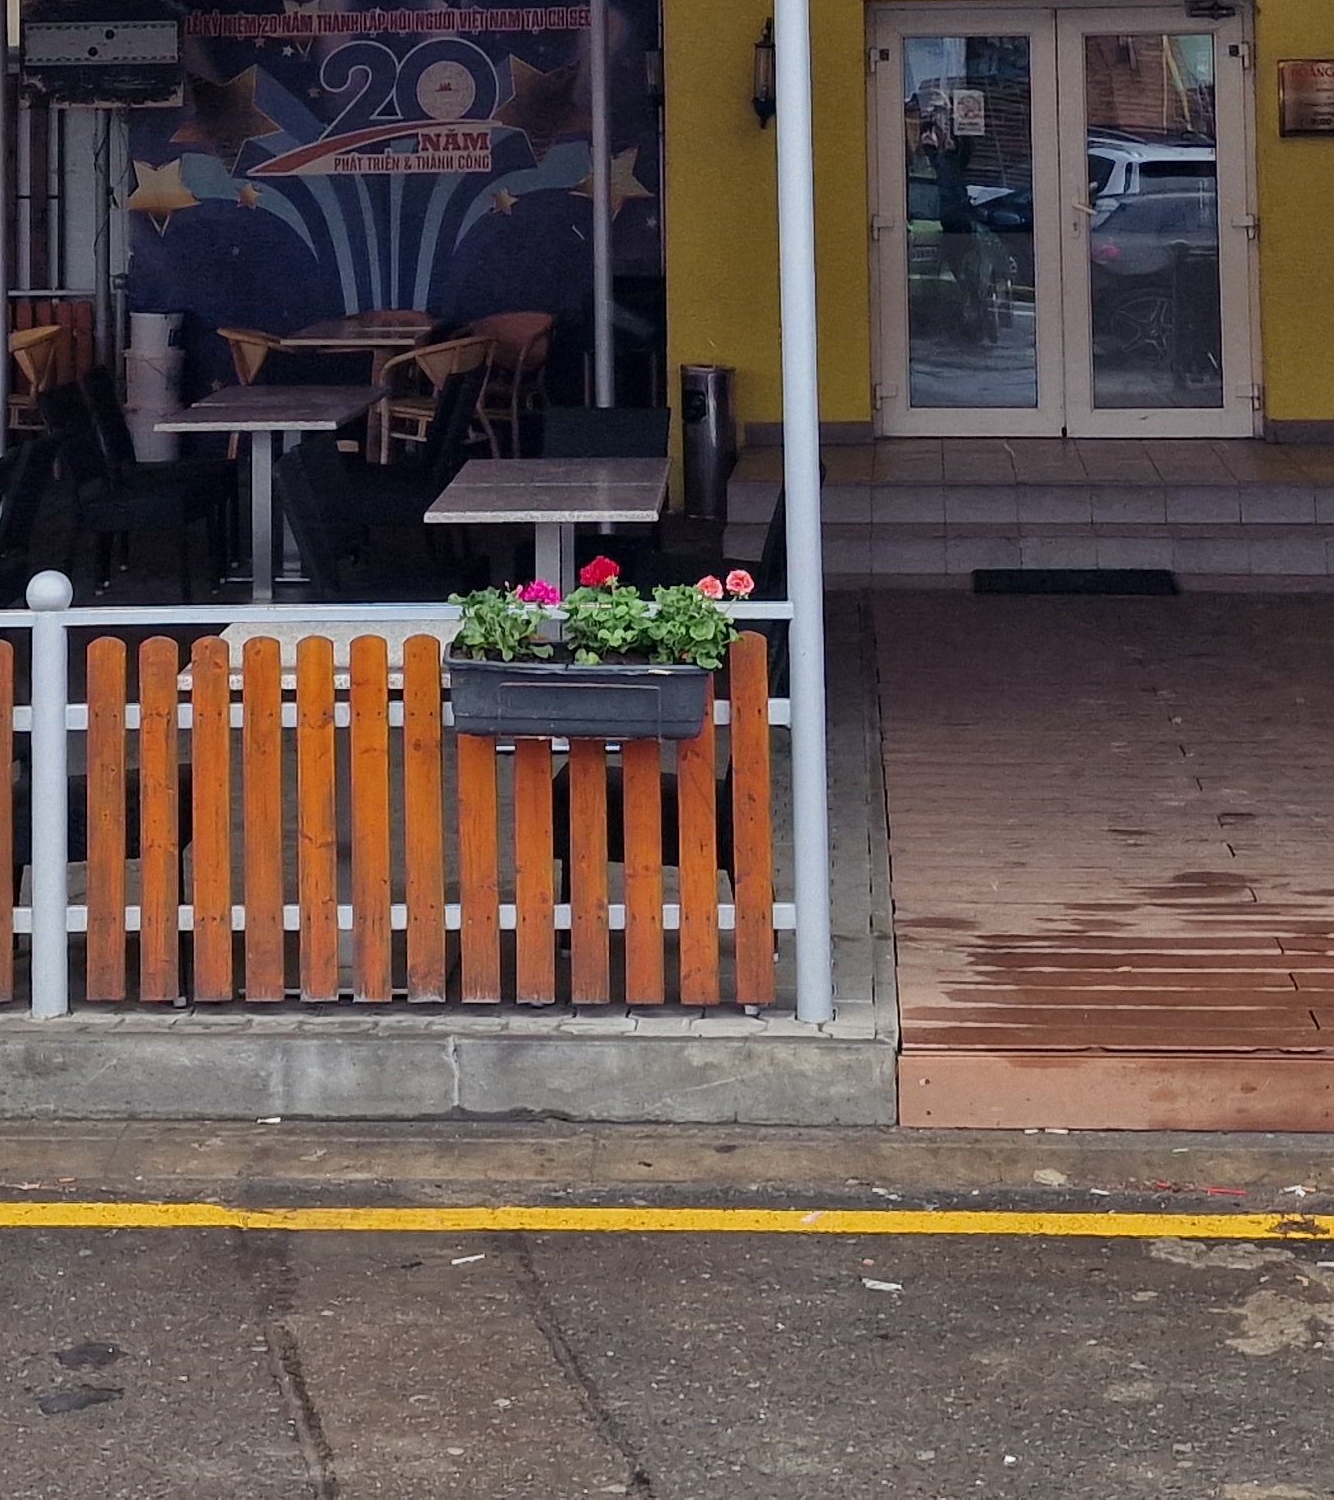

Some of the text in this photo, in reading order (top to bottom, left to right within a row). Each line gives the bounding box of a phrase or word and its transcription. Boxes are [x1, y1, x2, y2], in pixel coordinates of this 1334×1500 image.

[258, 13, 278, 36] 20
[488, 7, 521, 31] NAM
[319, 37, 499, 142] 20
[420, 128, 490, 152] NĂM
[403, 157, 412, 171] &
